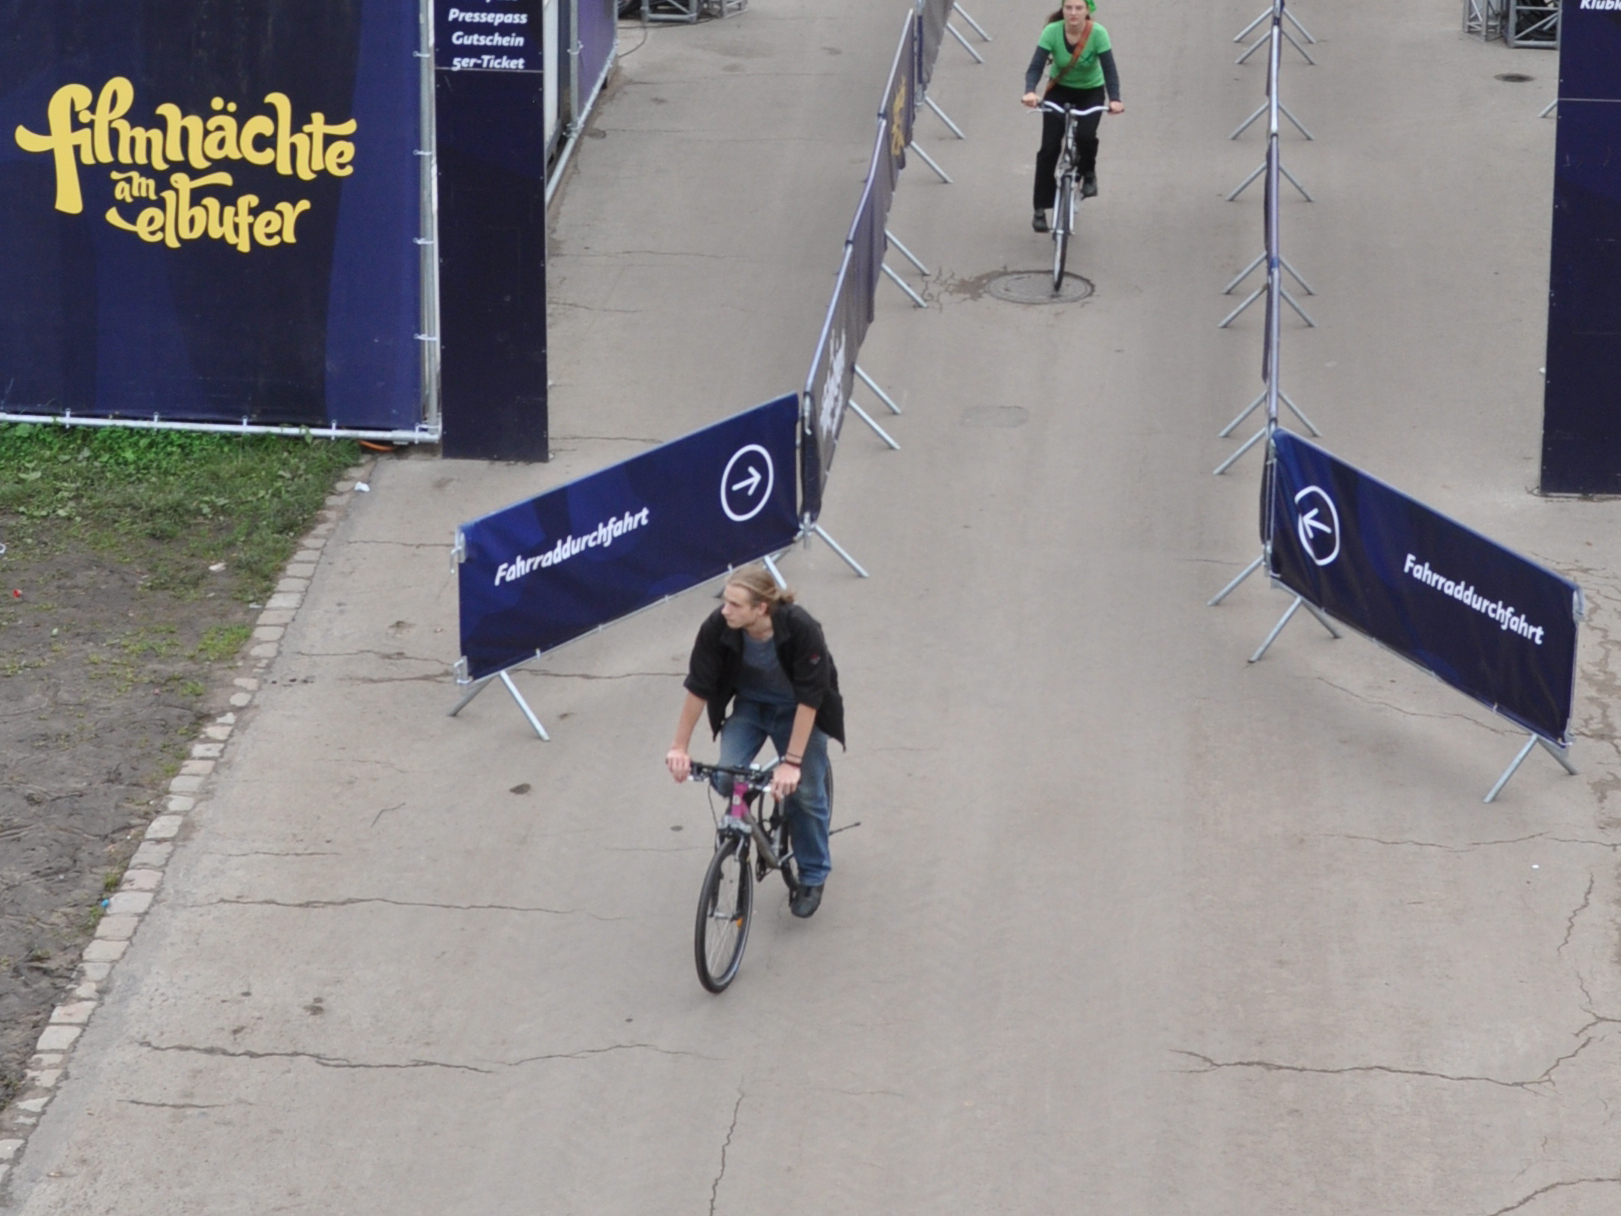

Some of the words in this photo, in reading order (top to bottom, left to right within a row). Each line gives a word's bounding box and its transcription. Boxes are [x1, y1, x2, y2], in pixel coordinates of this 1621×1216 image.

[448, 8, 528, 26] Pressepass
[451, 31, 525, 47] Gutschein
[452, 55, 526, 71] 5er-Ticket
[14, 76, 358, 215] filmnächte
[105, 171, 311, 253] elbufer
[110, 170, 158, 203] am
[494, 506, 650, 587] Fahrraddurchfahrt
[1403, 553, 1545, 646] Fahrraddurchfahrt
